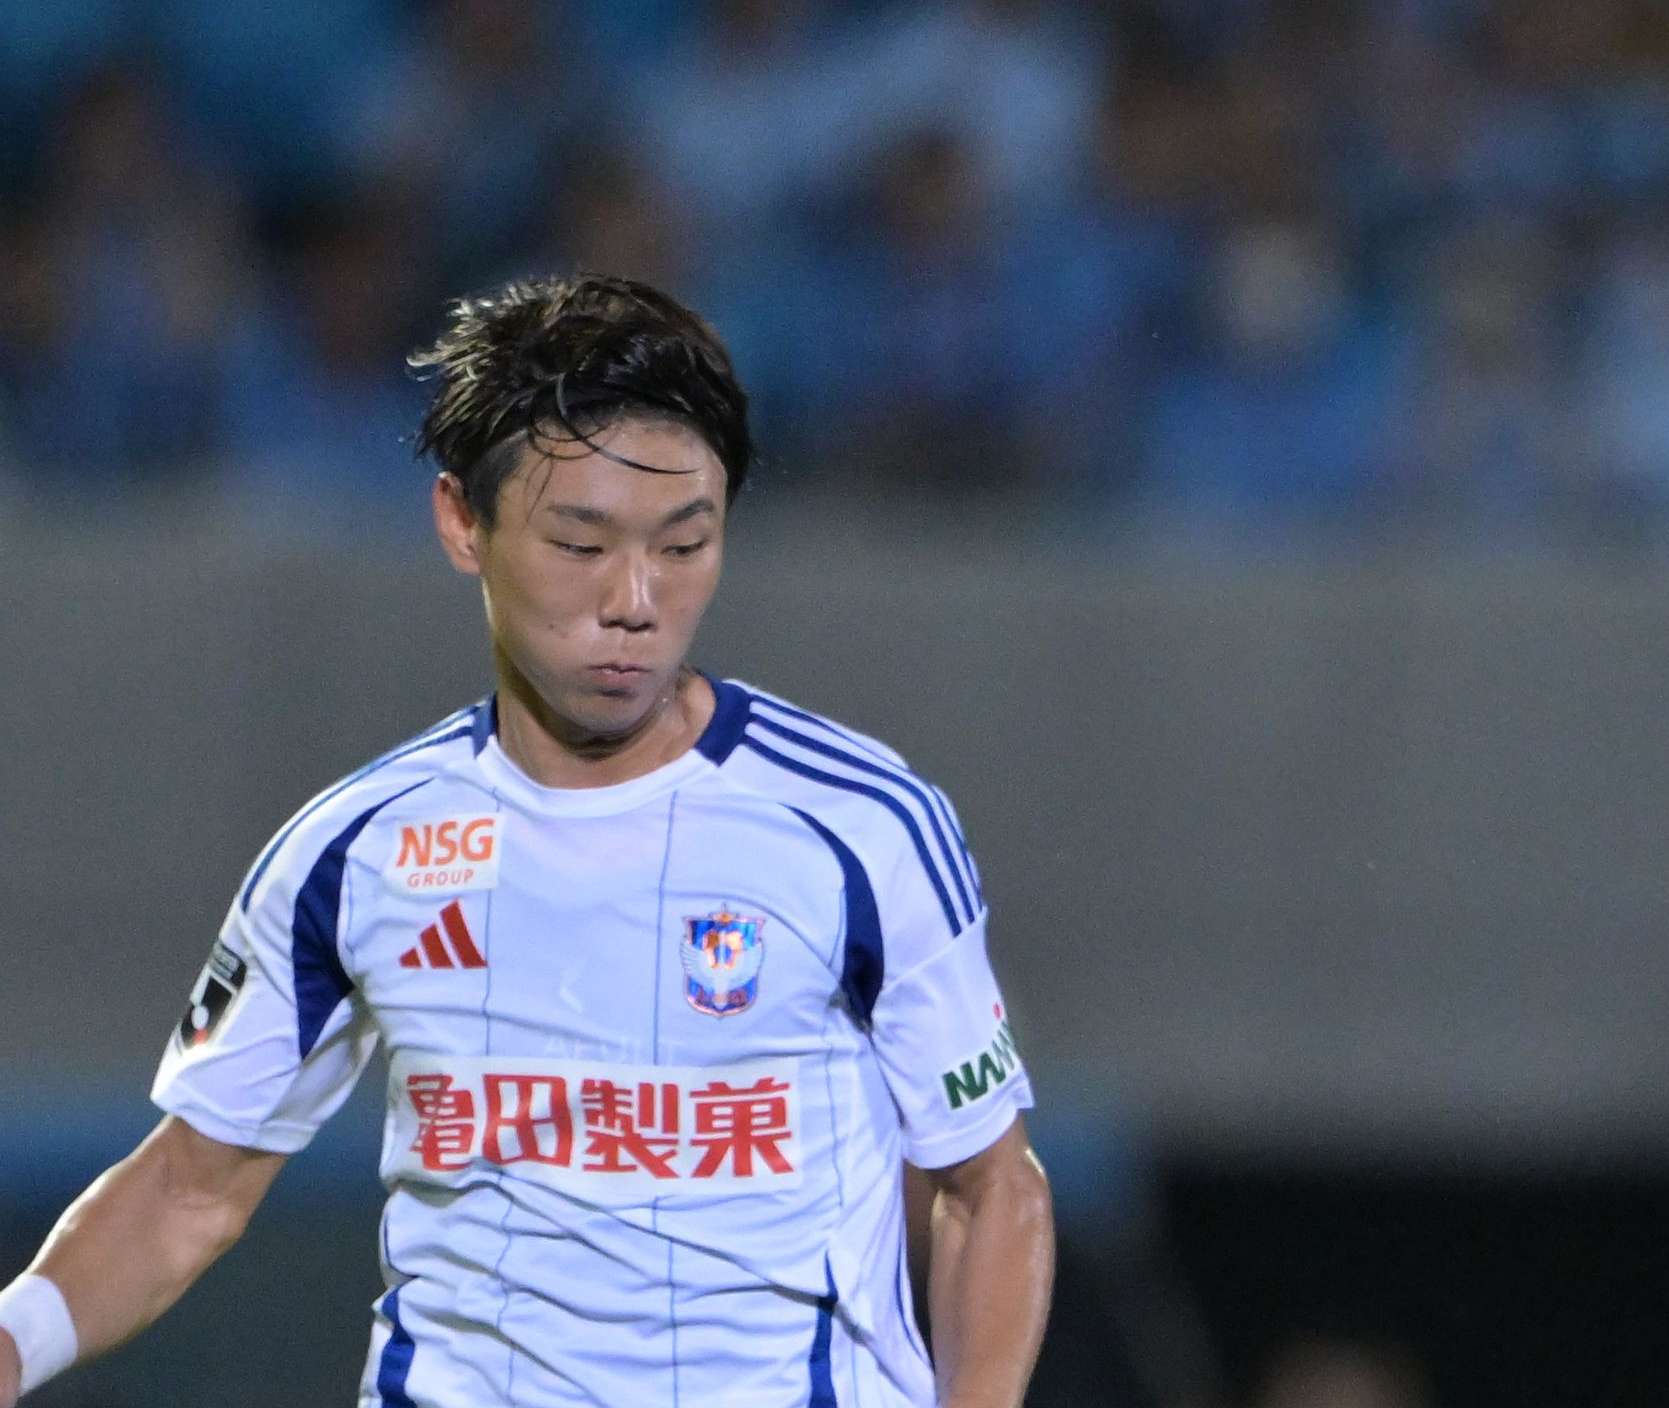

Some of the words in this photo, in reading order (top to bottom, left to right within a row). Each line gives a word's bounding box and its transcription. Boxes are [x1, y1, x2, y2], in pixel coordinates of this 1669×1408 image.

[395, 817, 495, 868] NSG
[407, 868, 474, 887] GROUP
[406, 1072, 795, 1180] 亀田製菓
